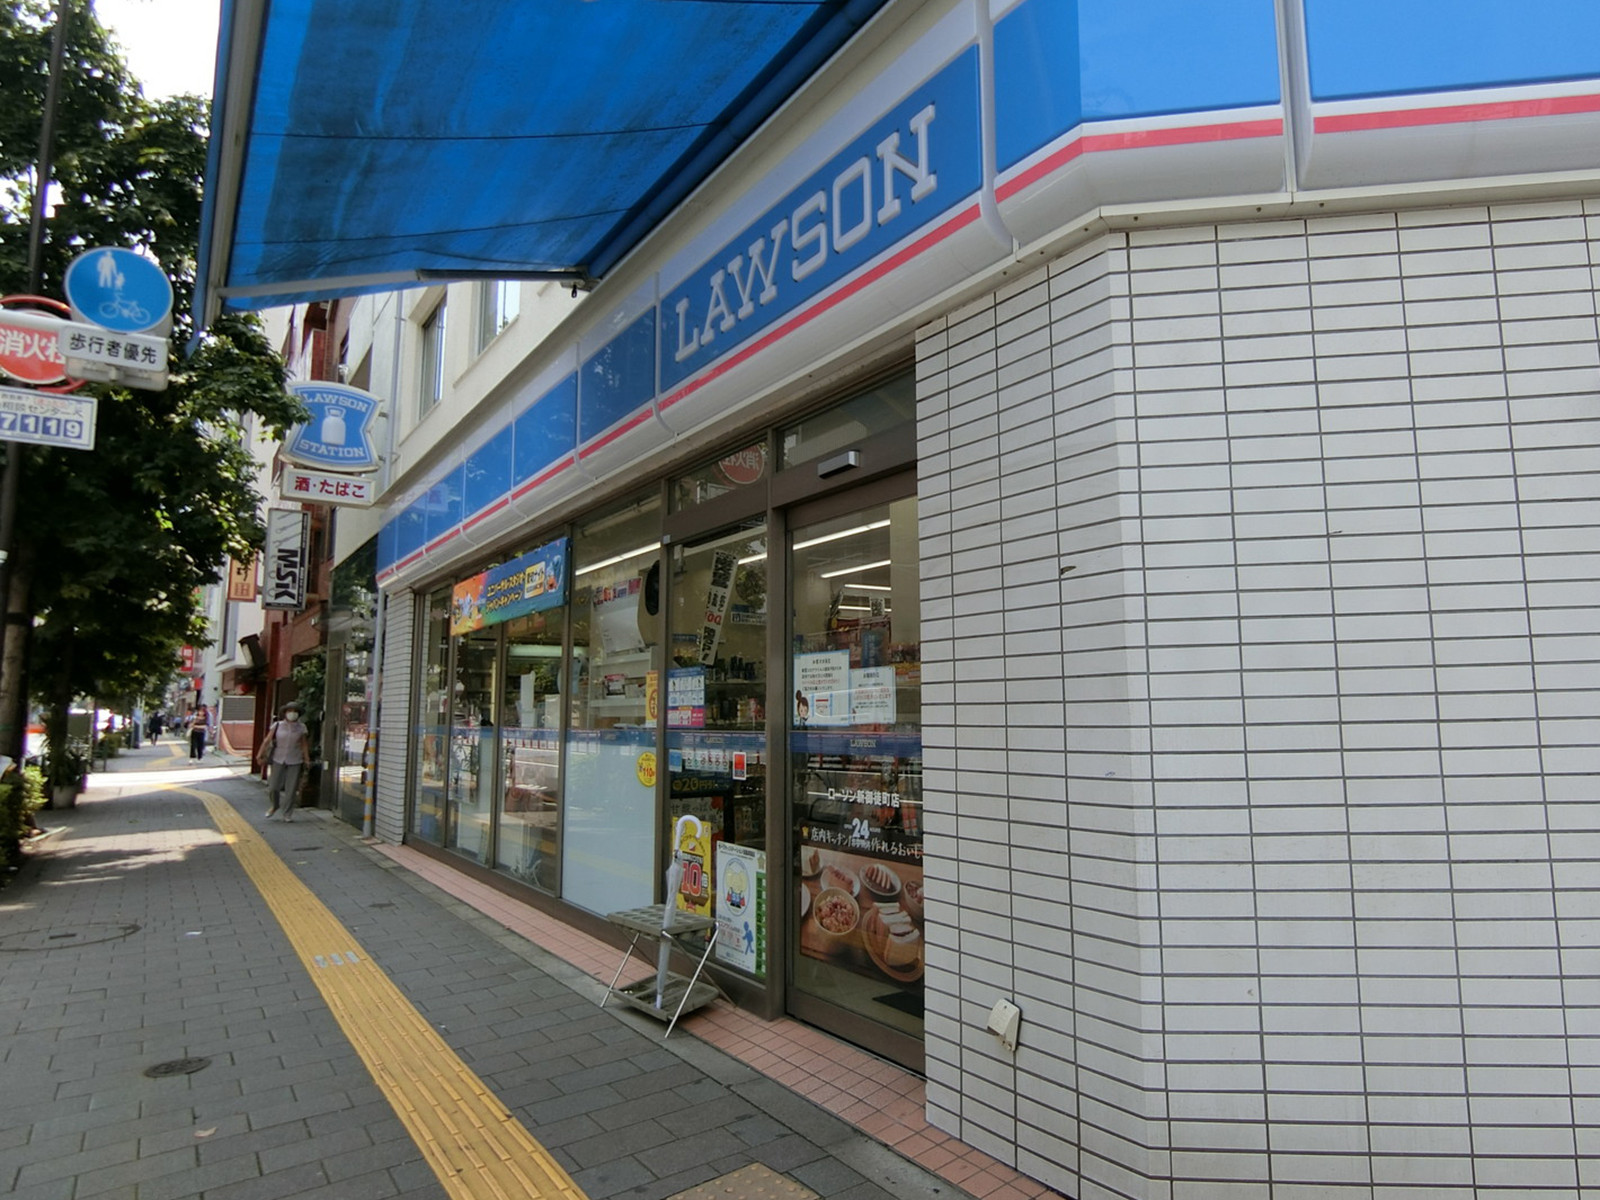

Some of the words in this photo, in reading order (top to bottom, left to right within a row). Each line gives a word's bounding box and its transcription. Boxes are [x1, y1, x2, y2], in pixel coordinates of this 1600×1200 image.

[675, 103, 937, 362] LAWSON
[70, 333, 156, 364] 歩行者優先
[302, 392, 369, 412] LAWSON
[300, 439, 365, 457] STATION
[294, 476, 365, 498] 酒・たばこ
[852, 818, 870, 839] 24
